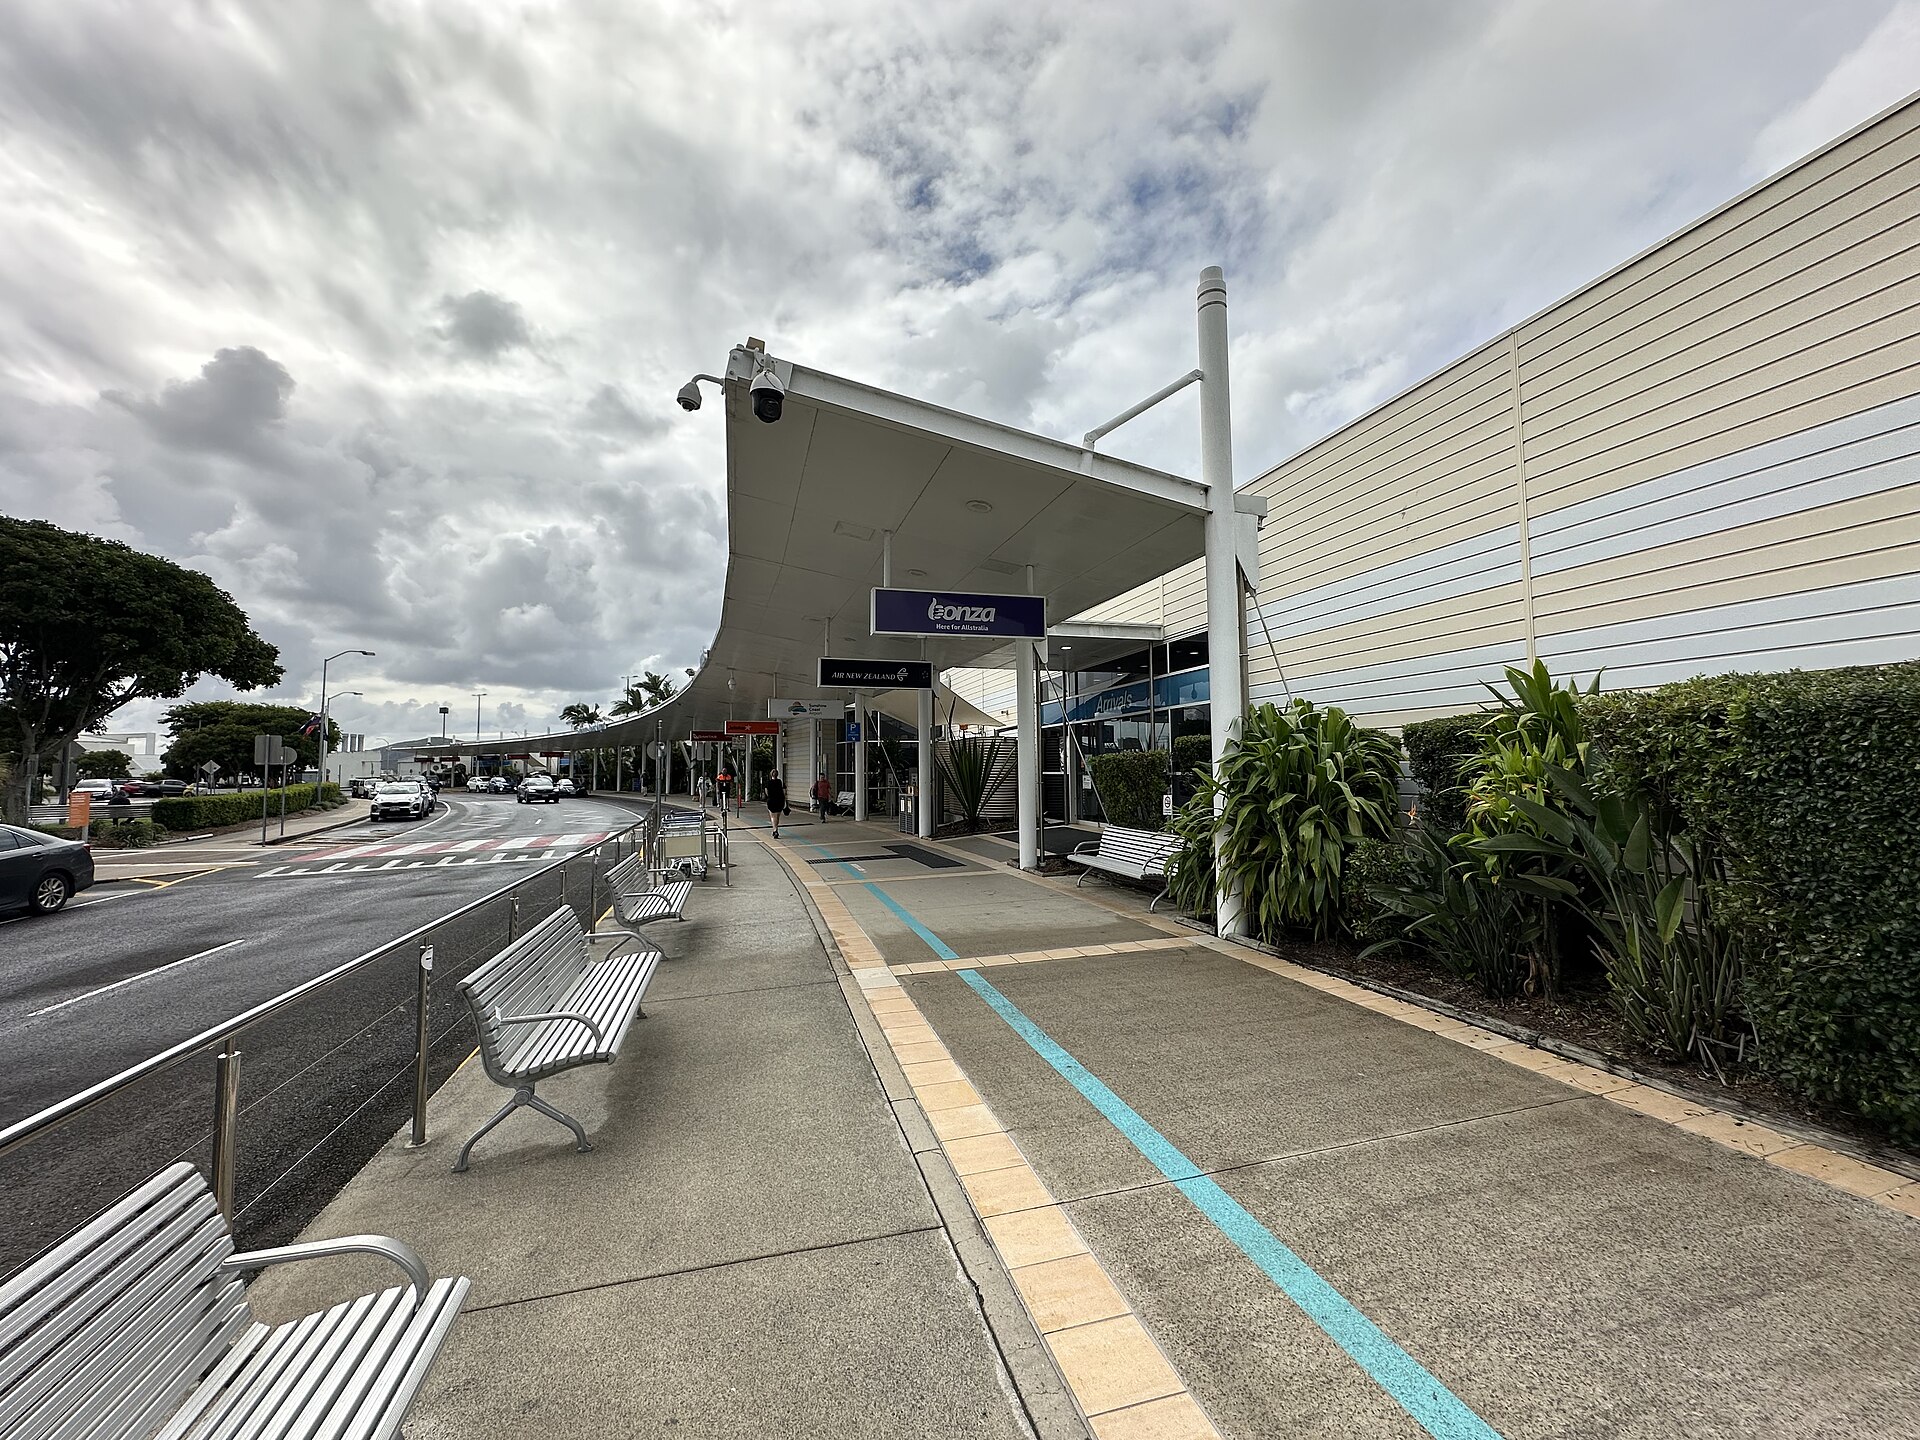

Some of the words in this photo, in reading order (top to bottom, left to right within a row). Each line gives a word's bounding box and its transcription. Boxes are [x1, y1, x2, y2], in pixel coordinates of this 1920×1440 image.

[928, 597, 996, 622] bonza
[1096, 690, 1133, 712] Arrivals
[850, 723, 857, 731] P
